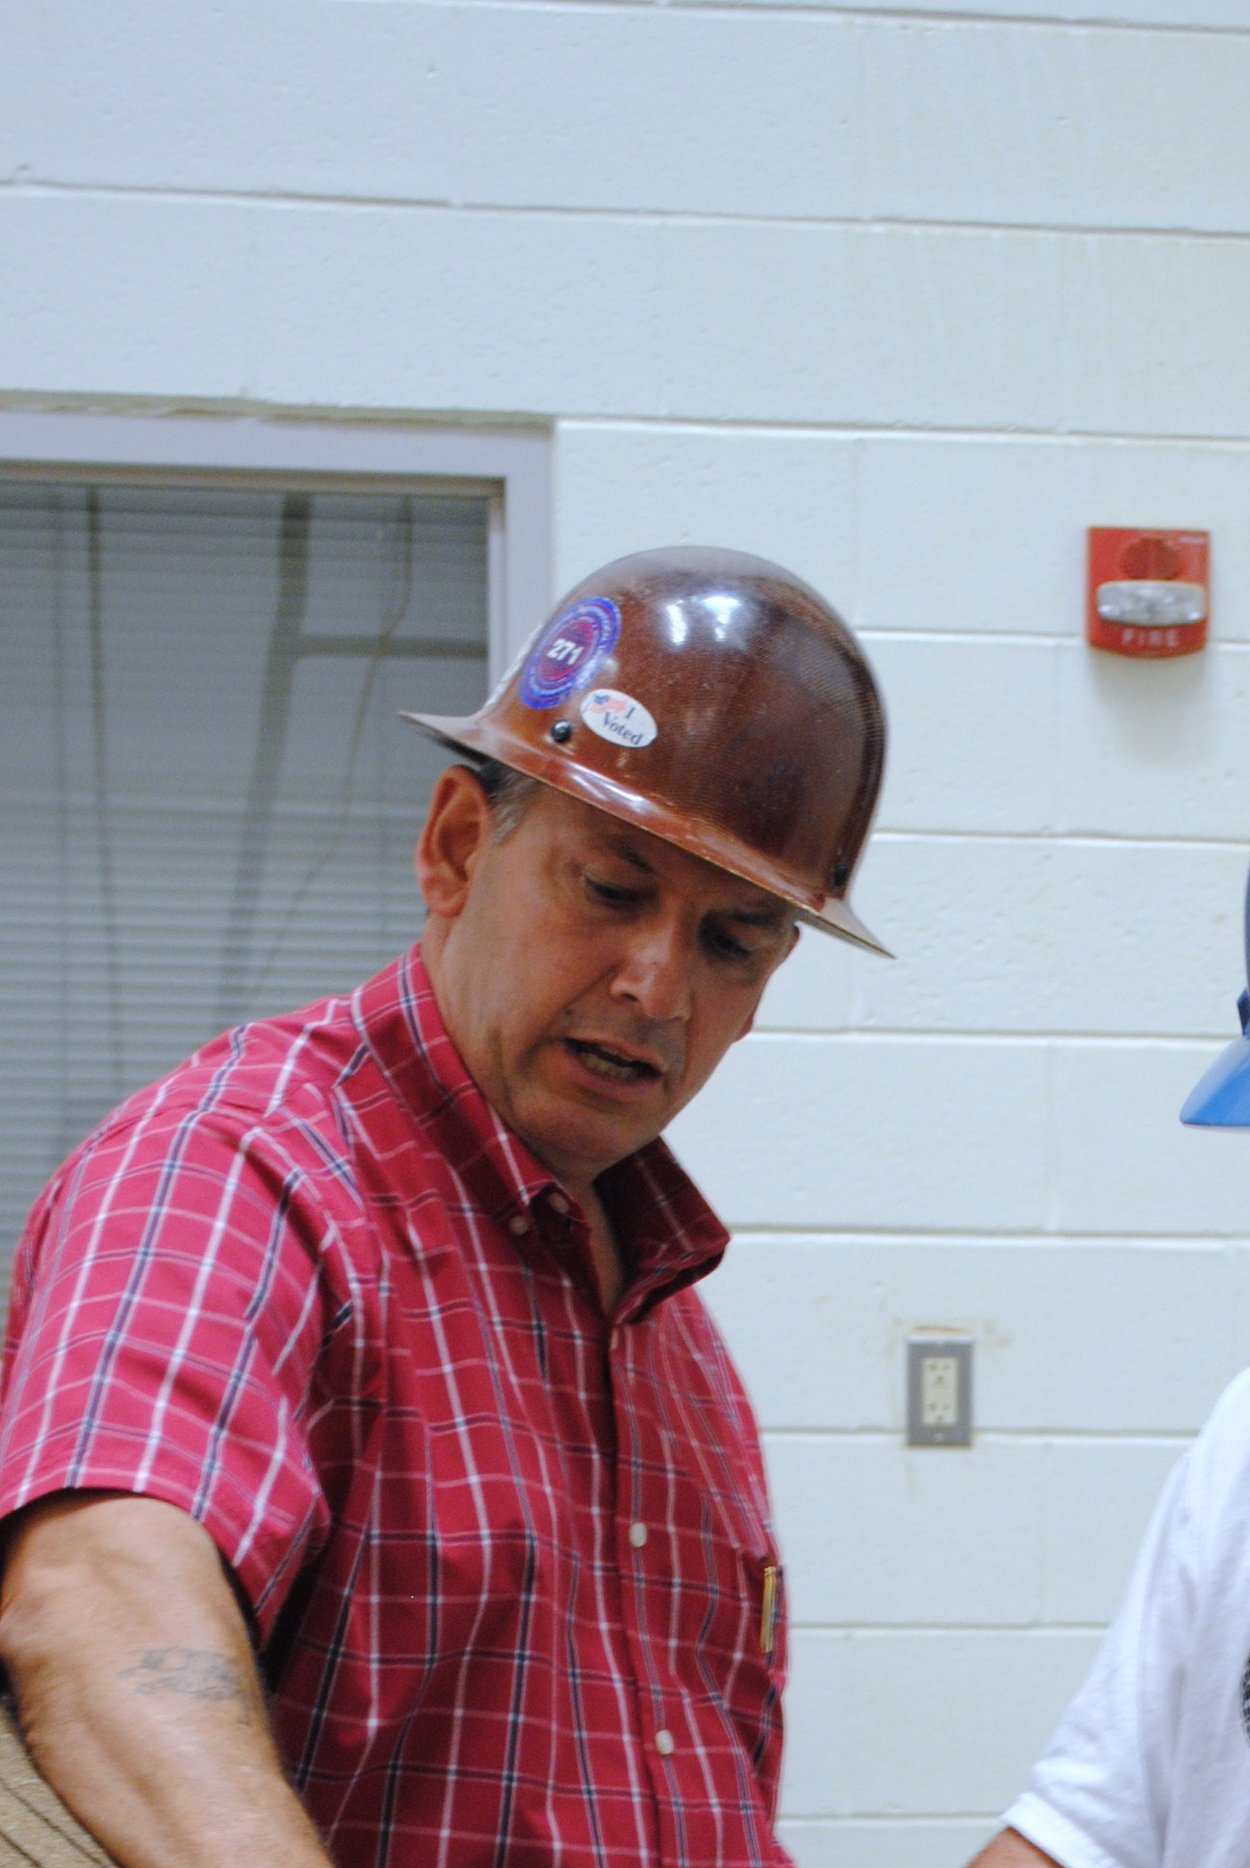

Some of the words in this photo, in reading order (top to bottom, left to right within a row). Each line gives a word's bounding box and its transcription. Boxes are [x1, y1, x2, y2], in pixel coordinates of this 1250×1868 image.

[546, 638, 584, 665] 271
[625, 706, 636, 719] I
[602, 711, 643, 745] Voted
